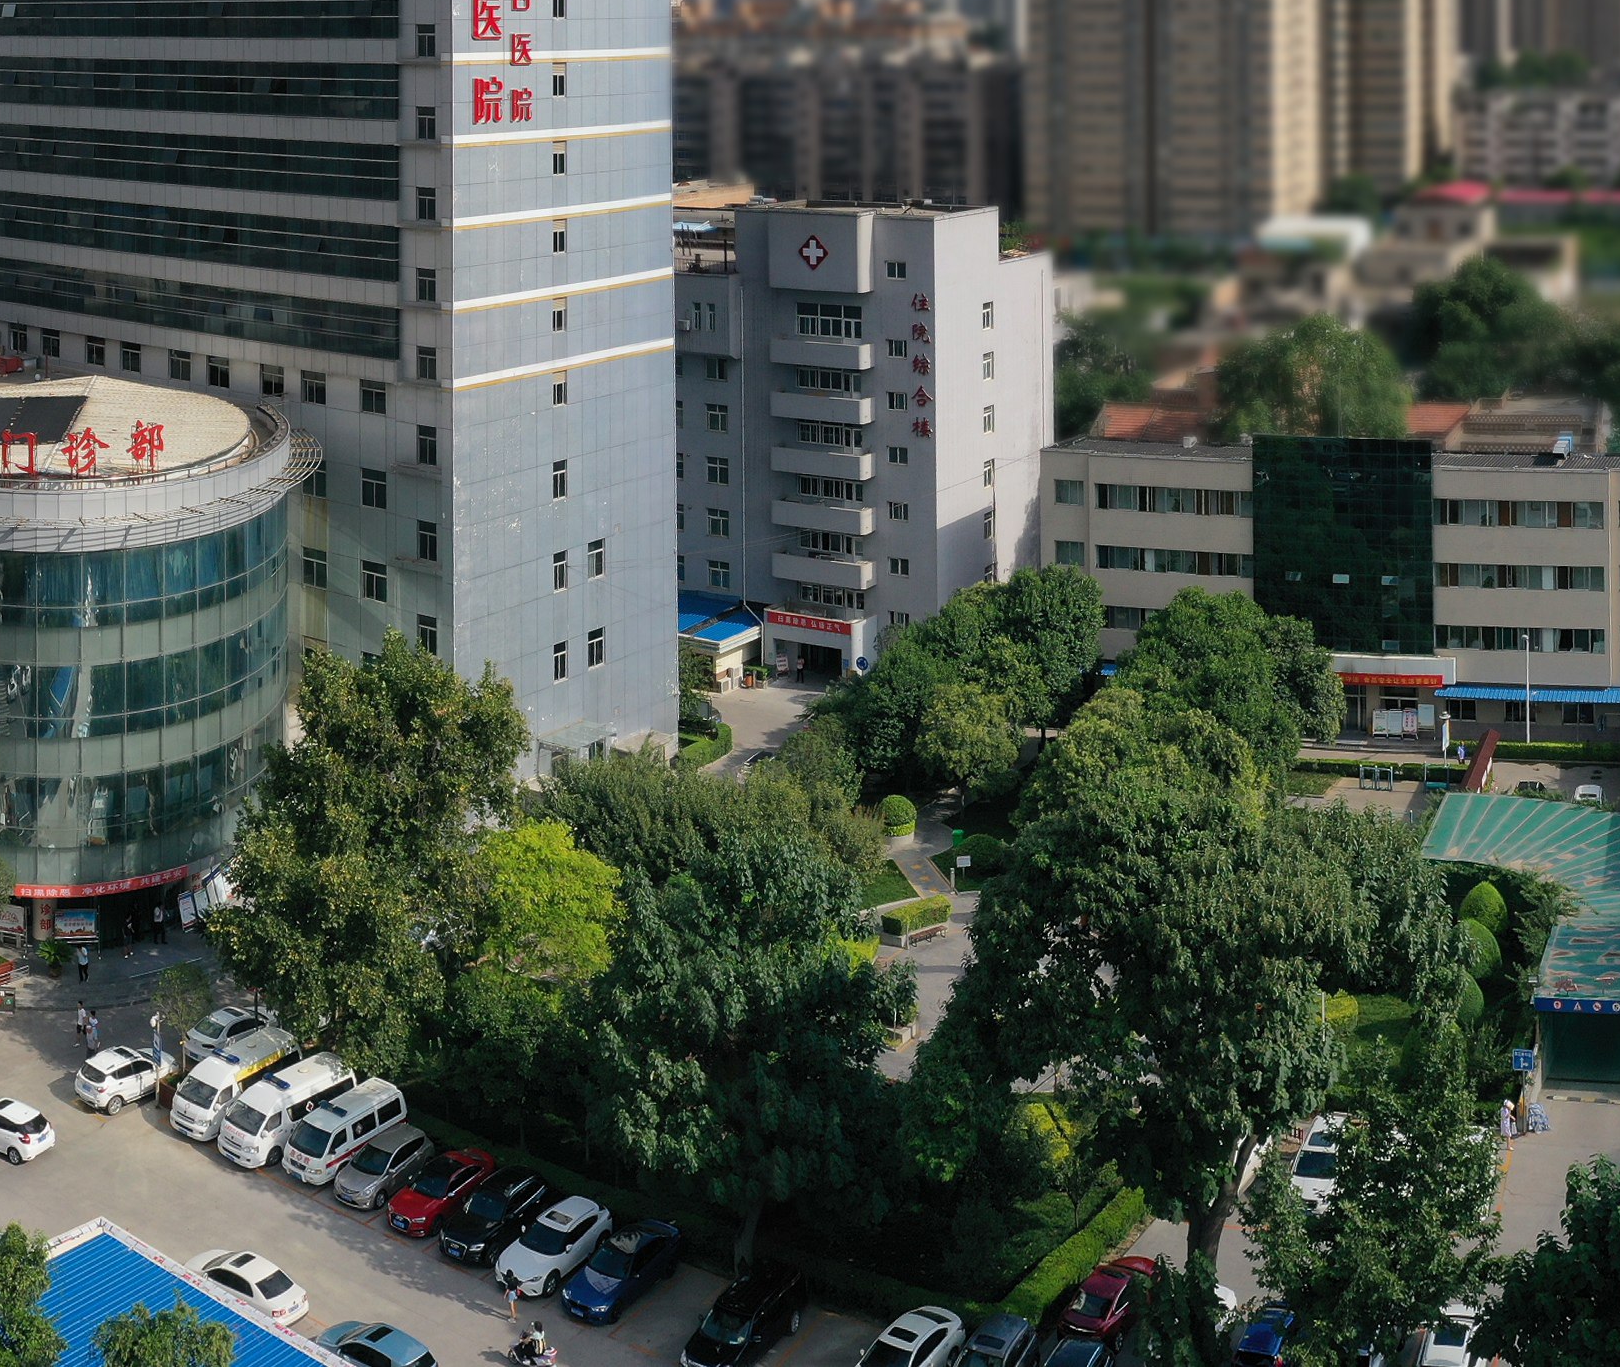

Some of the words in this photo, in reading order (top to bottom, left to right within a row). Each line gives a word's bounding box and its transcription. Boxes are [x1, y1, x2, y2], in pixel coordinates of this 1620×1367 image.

[911, 293, 933, 438] 住院综合楼
[2, 420, 164, 475] 门诊部
[21, 888, 71, 897] 扫黑除恶
[82, 881, 131, 895] 净化环境
